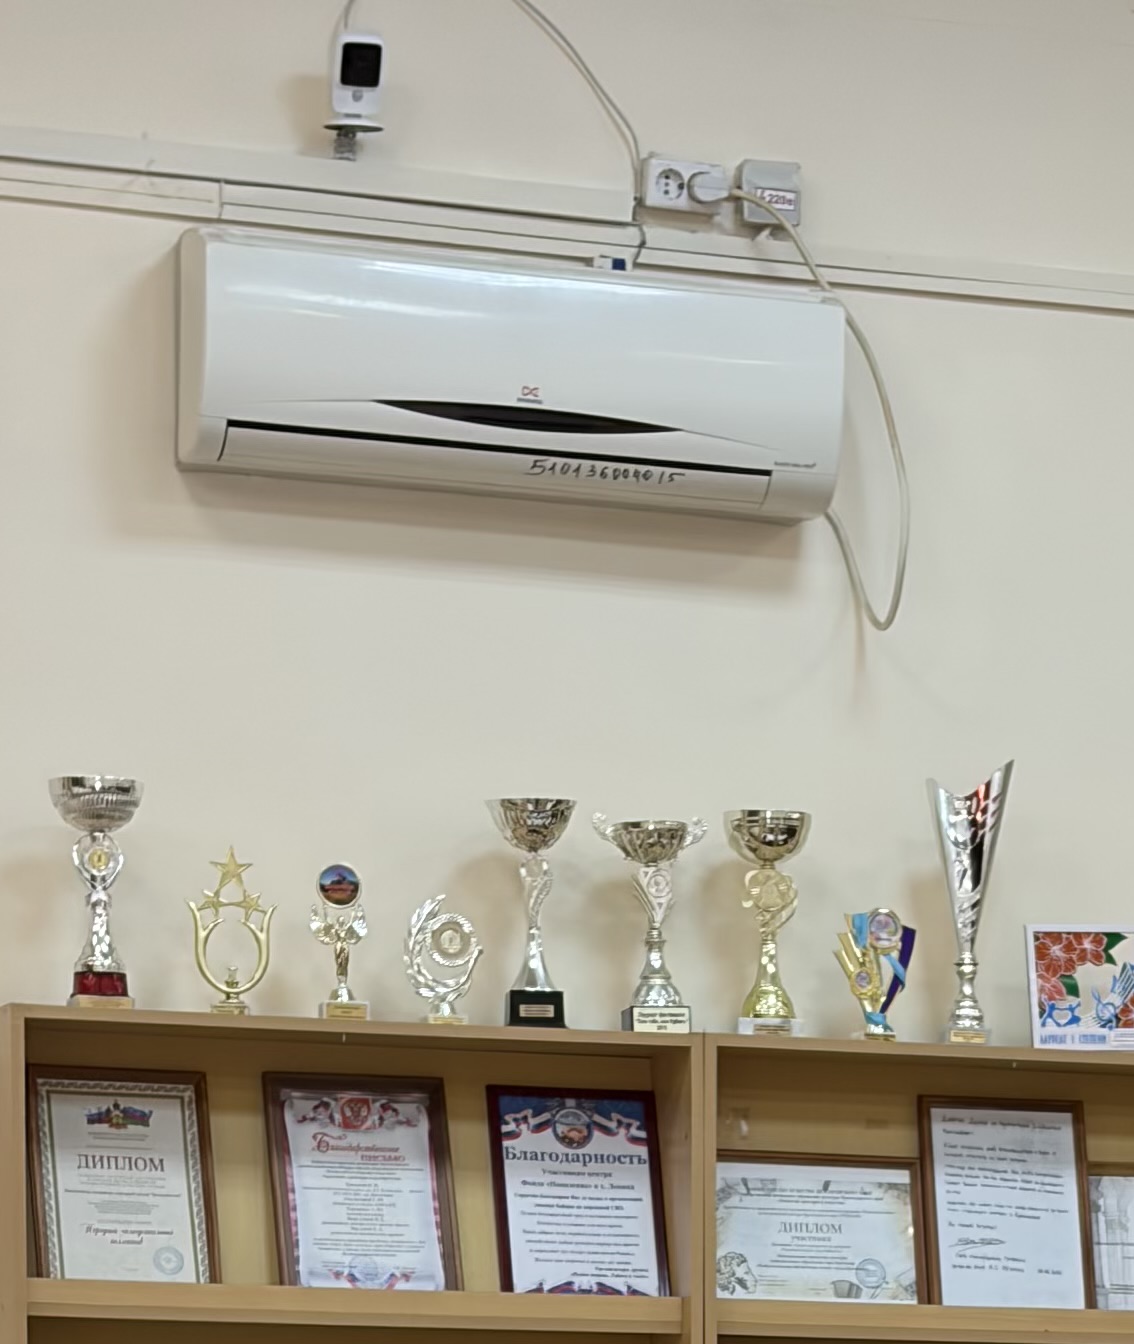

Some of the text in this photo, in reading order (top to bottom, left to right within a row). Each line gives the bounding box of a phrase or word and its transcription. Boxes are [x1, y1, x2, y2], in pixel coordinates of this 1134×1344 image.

[77, 1154, 165, 1172] ДИПЛОМ
[504, 1146, 648, 1167] Благодарность
[778, 1221, 842, 1234] ДИПЛОМ
